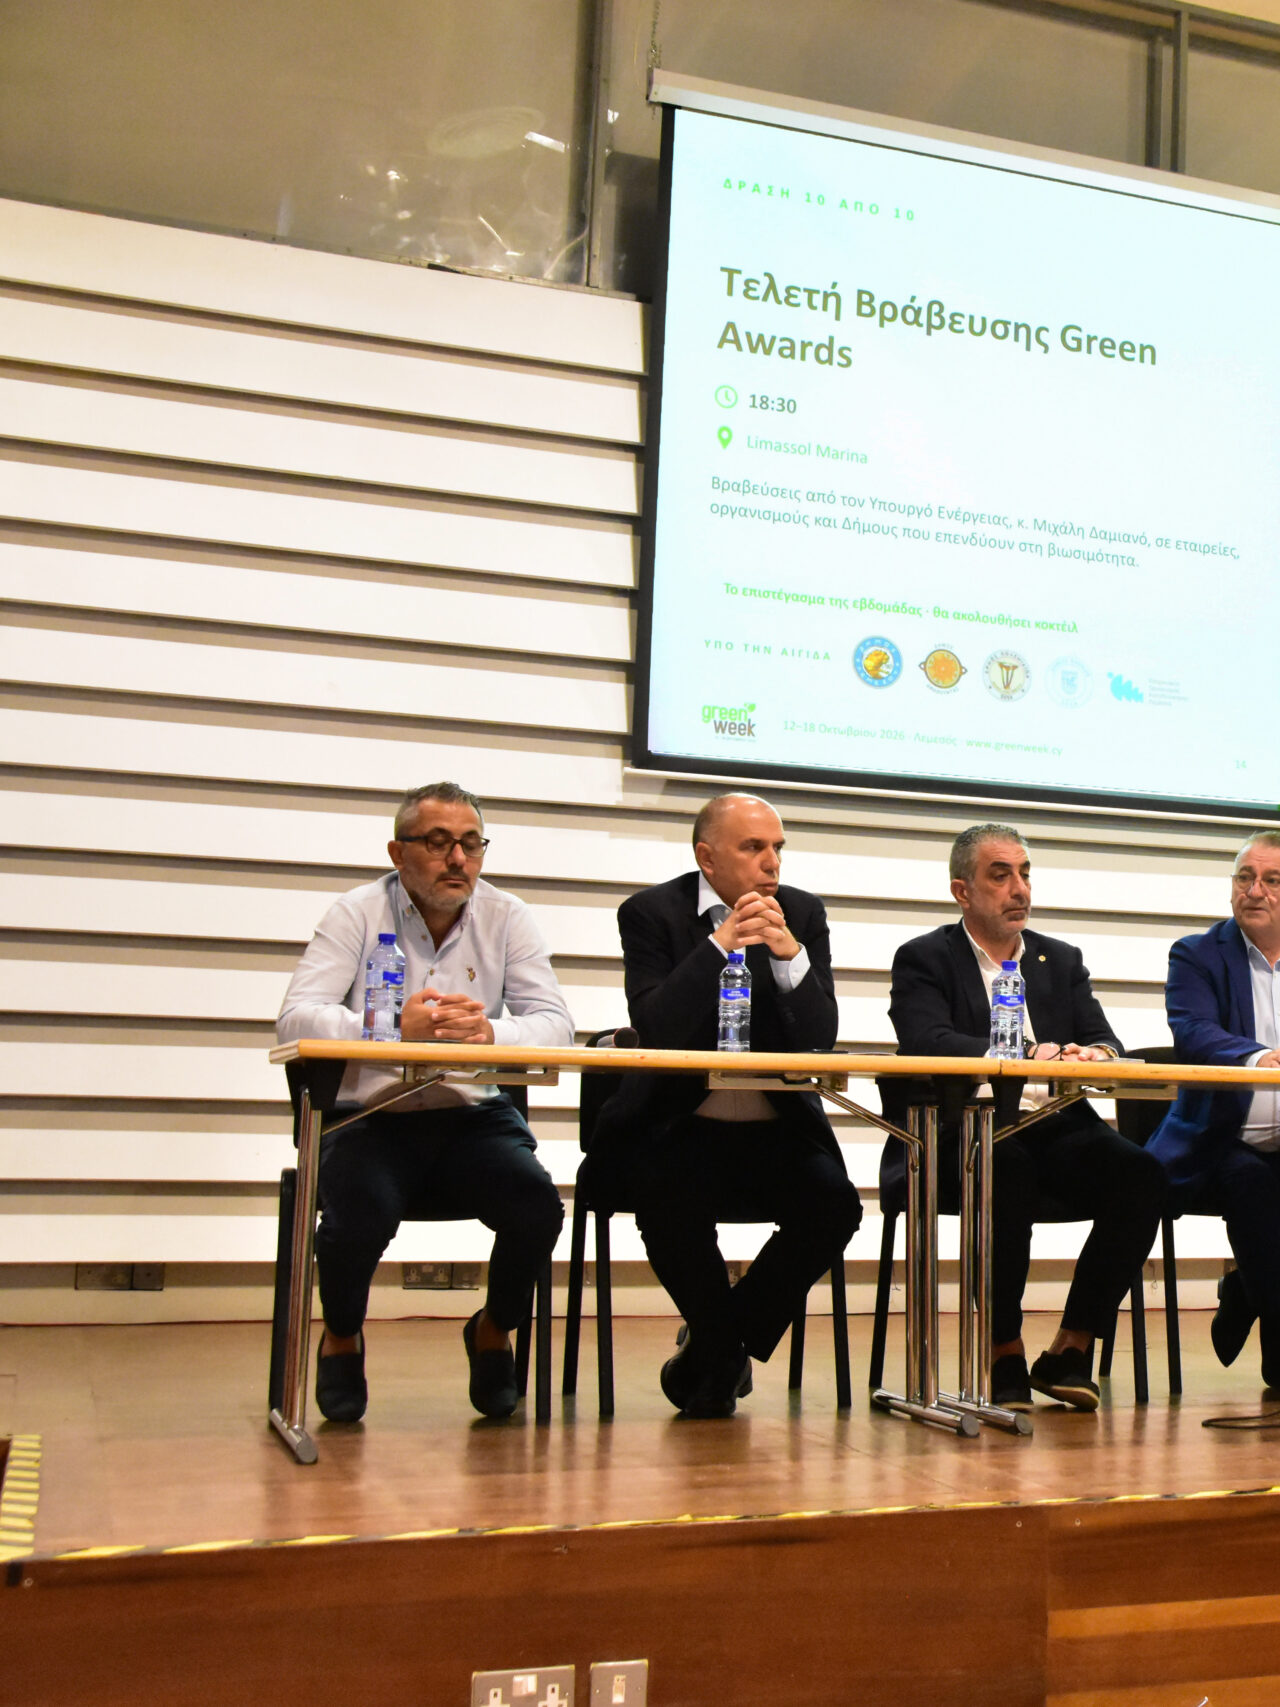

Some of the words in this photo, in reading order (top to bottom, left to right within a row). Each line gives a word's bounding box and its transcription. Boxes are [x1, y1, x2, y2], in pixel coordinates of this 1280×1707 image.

[723, 178, 790, 199] ΔΡΑΣΗ
[805, 192, 825, 206] 10
[839, 199, 880, 215] ΑΠΟ
[894, 208, 915, 221] 10
[719, 266, 843, 321] Τελετή
[856, 289, 1050, 354] Βράβευσης
[1060, 324, 1157, 366] Green
[717, 321, 853, 369] Awards
[748, 393, 797, 415] 18:30
[747, 435, 811, 457] Limassol
[816, 443, 868, 464] Marina
[710, 502, 809, 527] οργανισμούς
[814, 516, 837, 528] και
[842, 517, 898, 538] Δήμους
[902, 527, 931, 541] που
[935, 531, 1016, 551] επενδύουν
[1018, 540, 1043, 556] στη
[1047, 542, 1140, 568] βιωσιμότητα.
[711, 476, 801, 502] Βραβεύσεις
[806, 488, 836, 506] από
[841, 494, 865, 508] τον
[870, 497, 933, 519] Υπουργό
[938, 505, 1013, 529] Ενέργειας,
[1017, 518, 1029, 530] κ.
[1033, 518, 1085, 540] Μιχάλη
[1089, 526, 1151, 548] Δαμιανό,
[1155, 536, 1171, 549] σε
[1175, 539, 1240, 560] εταιρείες,
[724, 582, 739, 596] Το
[828, 596, 849, 609] της
[852, 598, 923, 617] εβδομάδας
[933, 606, 949, 619] θα
[702, 704, 748, 723] green
[714, 719, 756, 738] week
